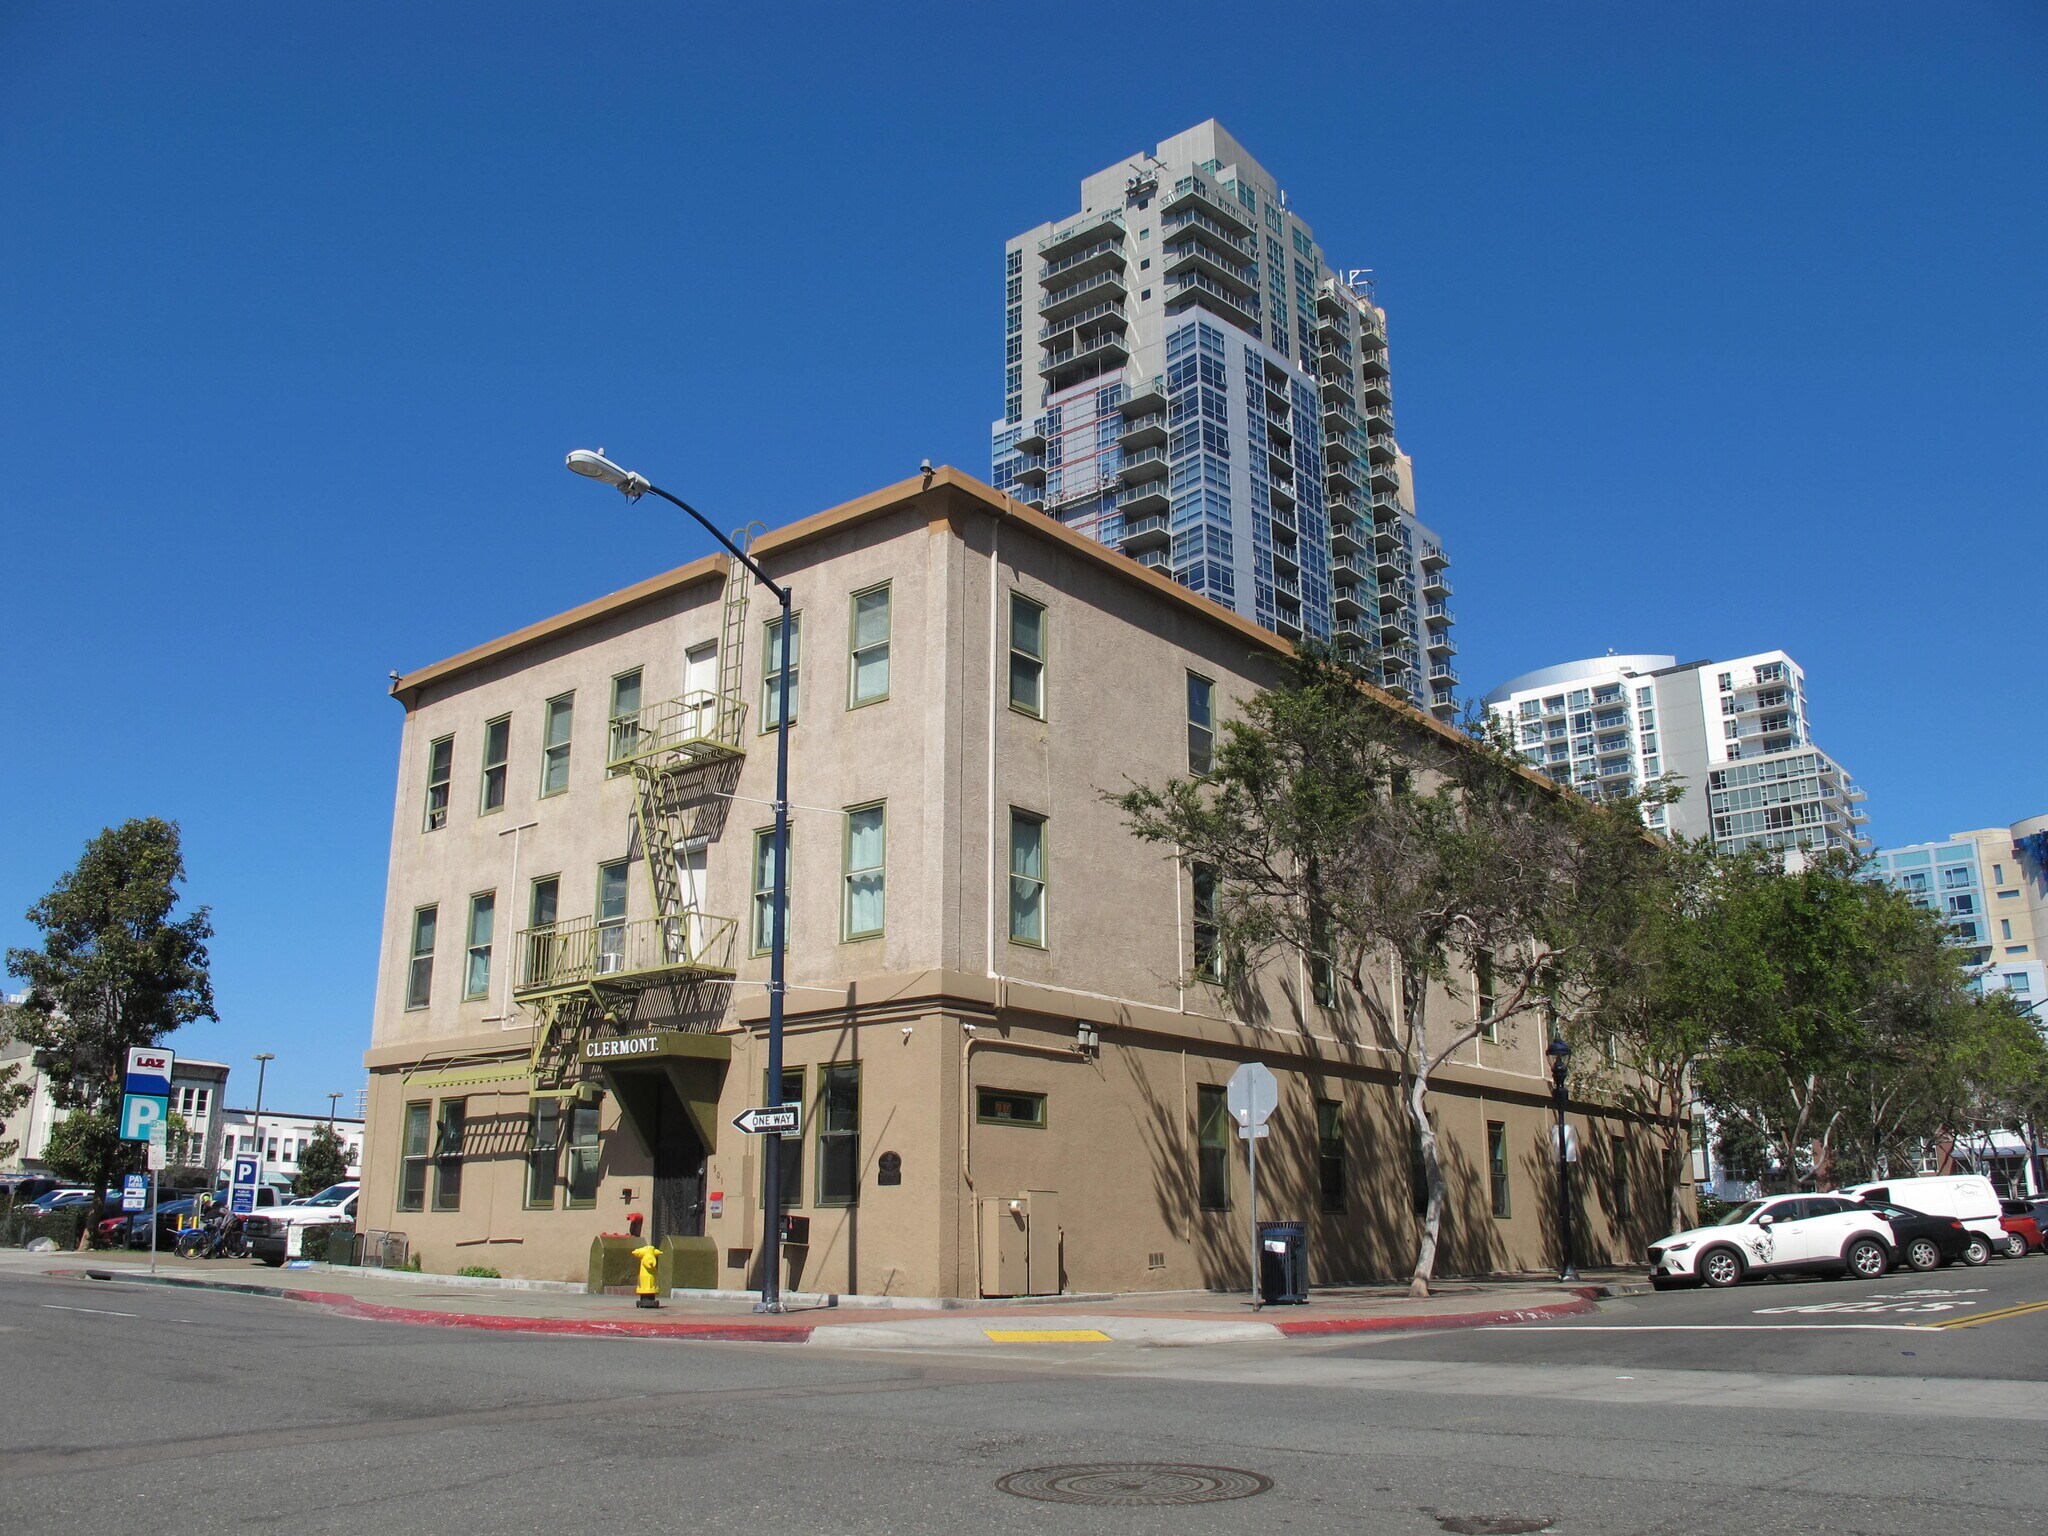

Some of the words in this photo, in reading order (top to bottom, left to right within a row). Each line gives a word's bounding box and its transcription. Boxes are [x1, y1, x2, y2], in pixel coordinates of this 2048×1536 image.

[137, 1057, 165, 1069] LAZ
[127, 1097, 160, 1138] P
[752, 1116, 771, 1126] ONE
[773, 1114, 792, 1125] WAY
[238, 1163, 253, 1181] P
